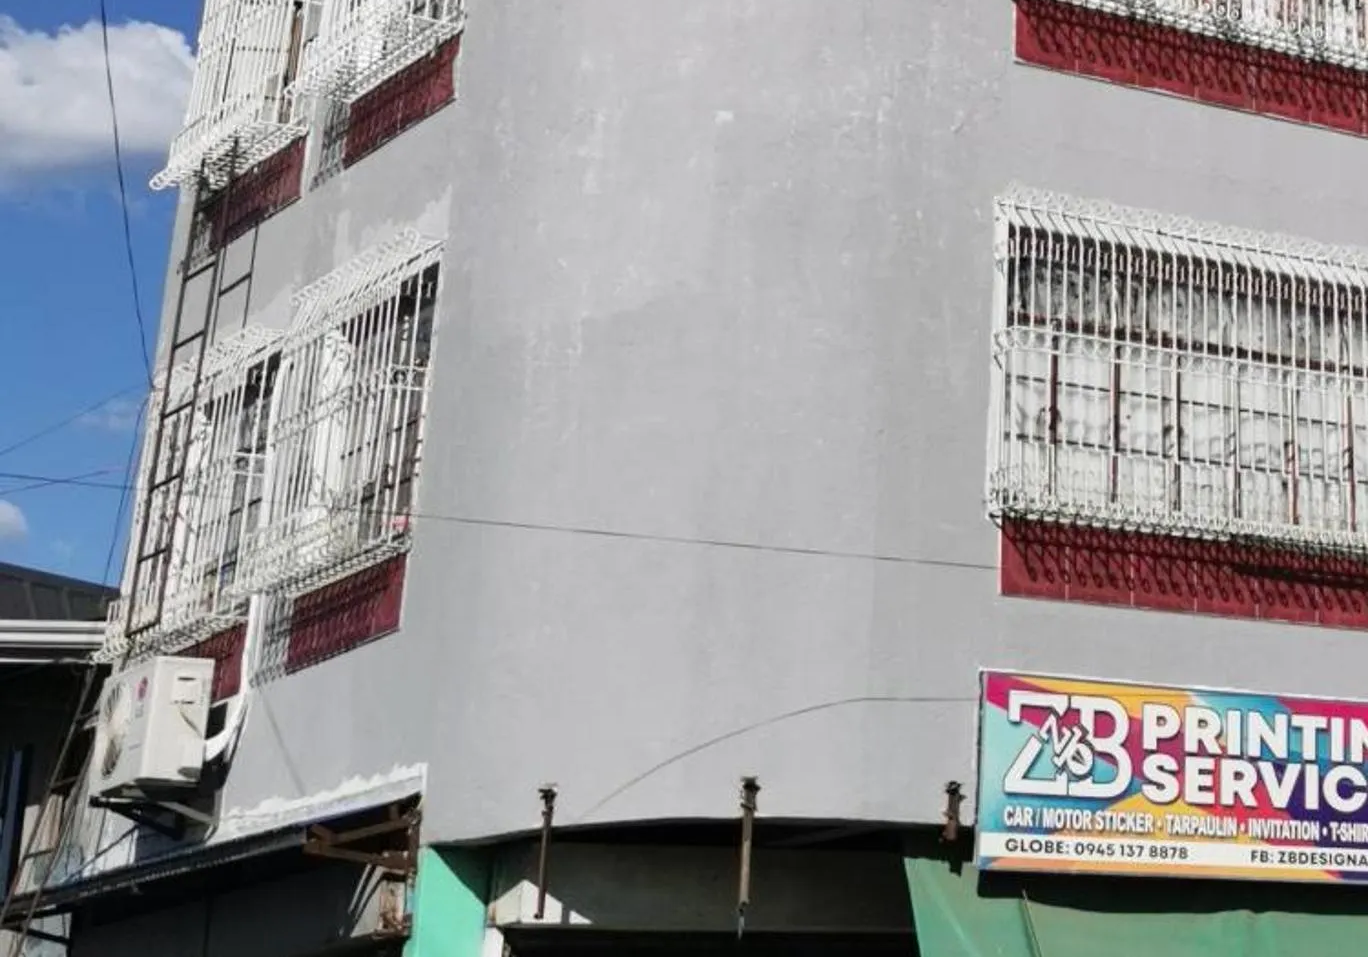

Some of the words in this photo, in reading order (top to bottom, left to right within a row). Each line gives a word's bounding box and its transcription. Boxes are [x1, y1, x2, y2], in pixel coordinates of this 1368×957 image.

[1004, 806, 1032, 827] CAR
[1043, 809, 1092, 831] MOTOR
[1095, 812, 1154, 834] STICKER
[1166, 814, 1236, 837] TARPAULIN
[1248, 819, 1320, 841] INVITATION
[1005, 838, 1070, 855] GLOBE:
[1074, 842, 1116, 857] 0945
[1120, 844, 1144, 858] 137
[1148, 845, 1188, 860] 8878
[1250, 850, 1274, 864] FB:
